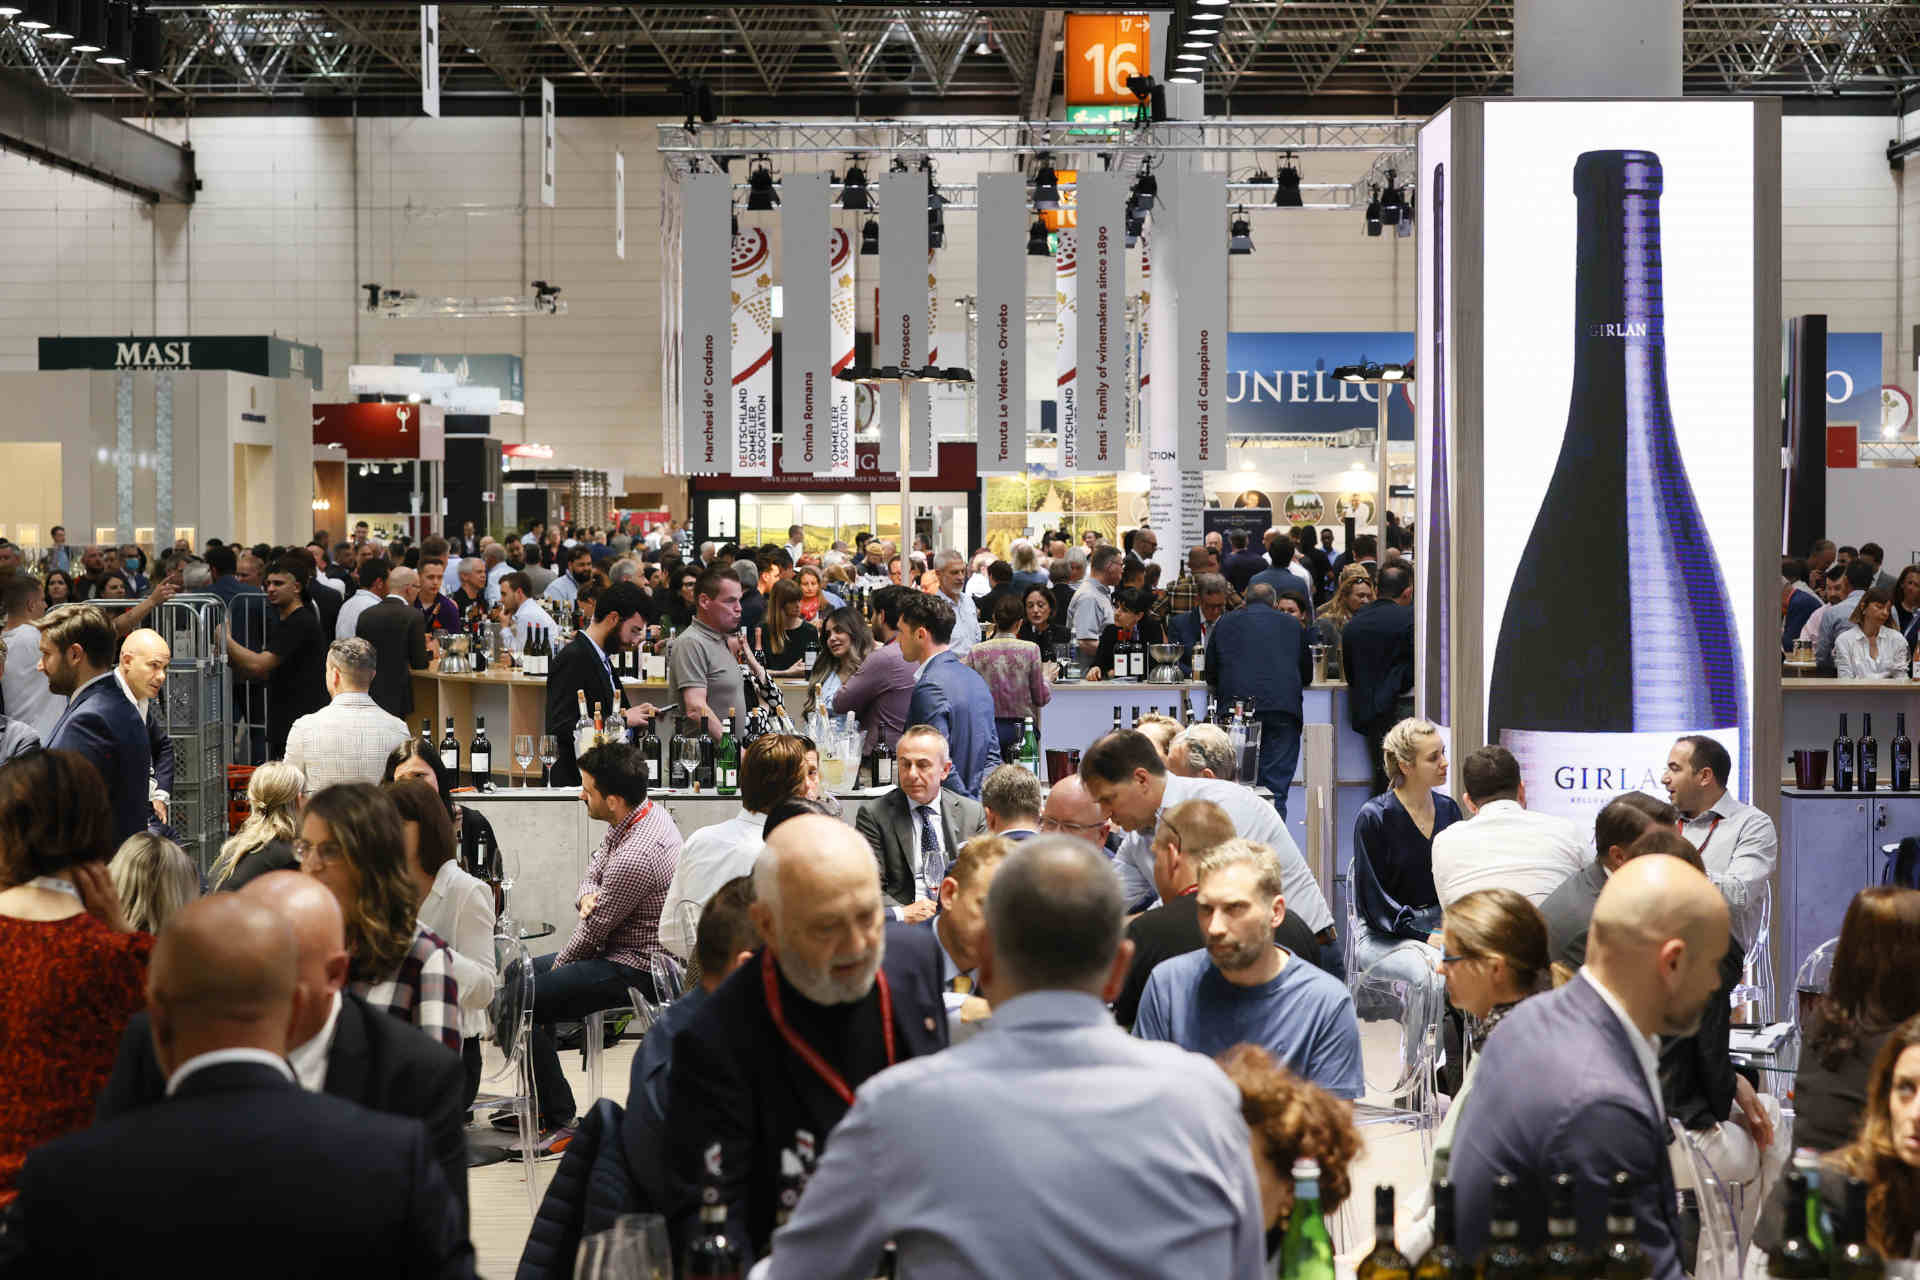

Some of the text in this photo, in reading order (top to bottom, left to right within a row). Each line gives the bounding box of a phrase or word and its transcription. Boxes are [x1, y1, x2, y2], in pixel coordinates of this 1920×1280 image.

[1120, 18, 1132, 32] 17
[1084, 43, 1139, 96] 16
[1097, 226, 1109, 256] 1890
[1098, 259, 1108, 289] since
[900, 314, 910, 369] Prosecco
[997, 304, 1008, 350] Orvieto
[1096, 292, 1108, 364] winemakers
[114, 342, 192, 366] MASI
[703, 334, 714, 386] Cordano
[1098, 367, 1108, 379] of
[997, 359, 1008, 402] Velette
[1097, 383, 1110, 420] Family
[1197, 329, 1210, 461] Fattoria di Calappiano
[702, 411, 714, 463] Marchesi
[738, 387, 748, 468] DEUTSCHLAND
[748, 406, 757, 468] SOMMELIER
[757, 395, 767, 468] ASSOCIATION
[803, 372, 814, 463] Omina Romana
[831, 406, 839, 468] SOMMELIER
[839, 395, 848, 468] ASSOCIATION
[998, 404, 1008, 418] Le
[1064, 388, 1075, 468] DEUTSCHLAND
[998, 421, 1009, 462] Tenuta
[1097, 430, 1108, 461] Sensi
[1555, 766, 1662, 790] GIRLA
